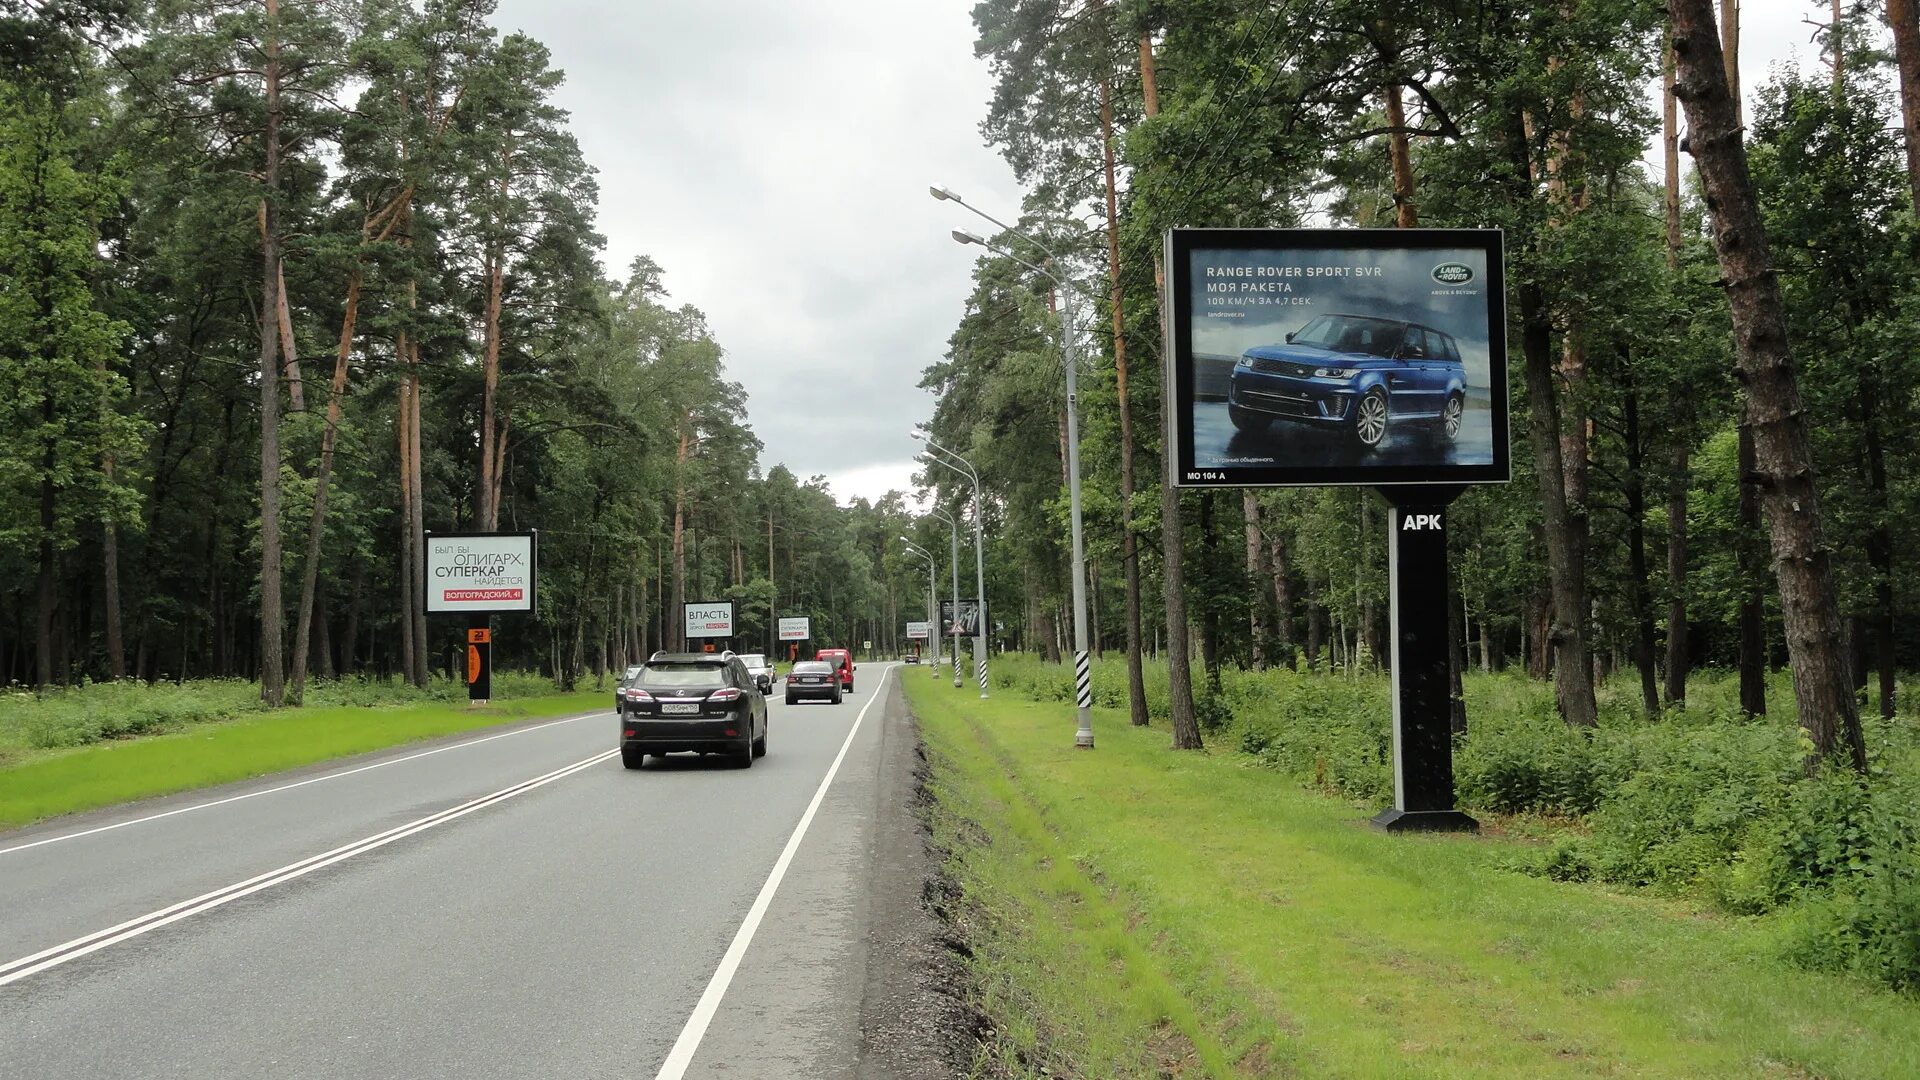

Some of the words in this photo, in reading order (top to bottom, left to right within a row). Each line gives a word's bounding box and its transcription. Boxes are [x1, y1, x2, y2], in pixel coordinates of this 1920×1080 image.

[1207, 267, 1253, 277] RANGE
[1257, 267, 1302, 277] ROVER
[1306, 267, 1350, 277] SPORT
[1355, 267, 1382, 277] SVR
[1440, 266, 1461, 274] LAND
[1442, 273, 1468, 281] ROVER
[1207, 282, 1236, 293] МОЯ
[1241, 282, 1292, 292] РАКЕТА
[1207, 297, 1225, 305] 100
[1227, 297, 1255, 306] КМ/Ч
[1258, 297, 1272, 305] ЗА
[1275, 297, 1289, 306] 4,7
[1203, 472, 1216, 480] 104
[435, 546, 454, 554] БЫЛ
[457, 546, 470, 554] БЫ
[454, 553, 524, 566] ОЛИГАРХ,
[435, 566, 505, 577] СУПЕРКАР
[689, 610, 729, 620] ВЛАСТЬ
